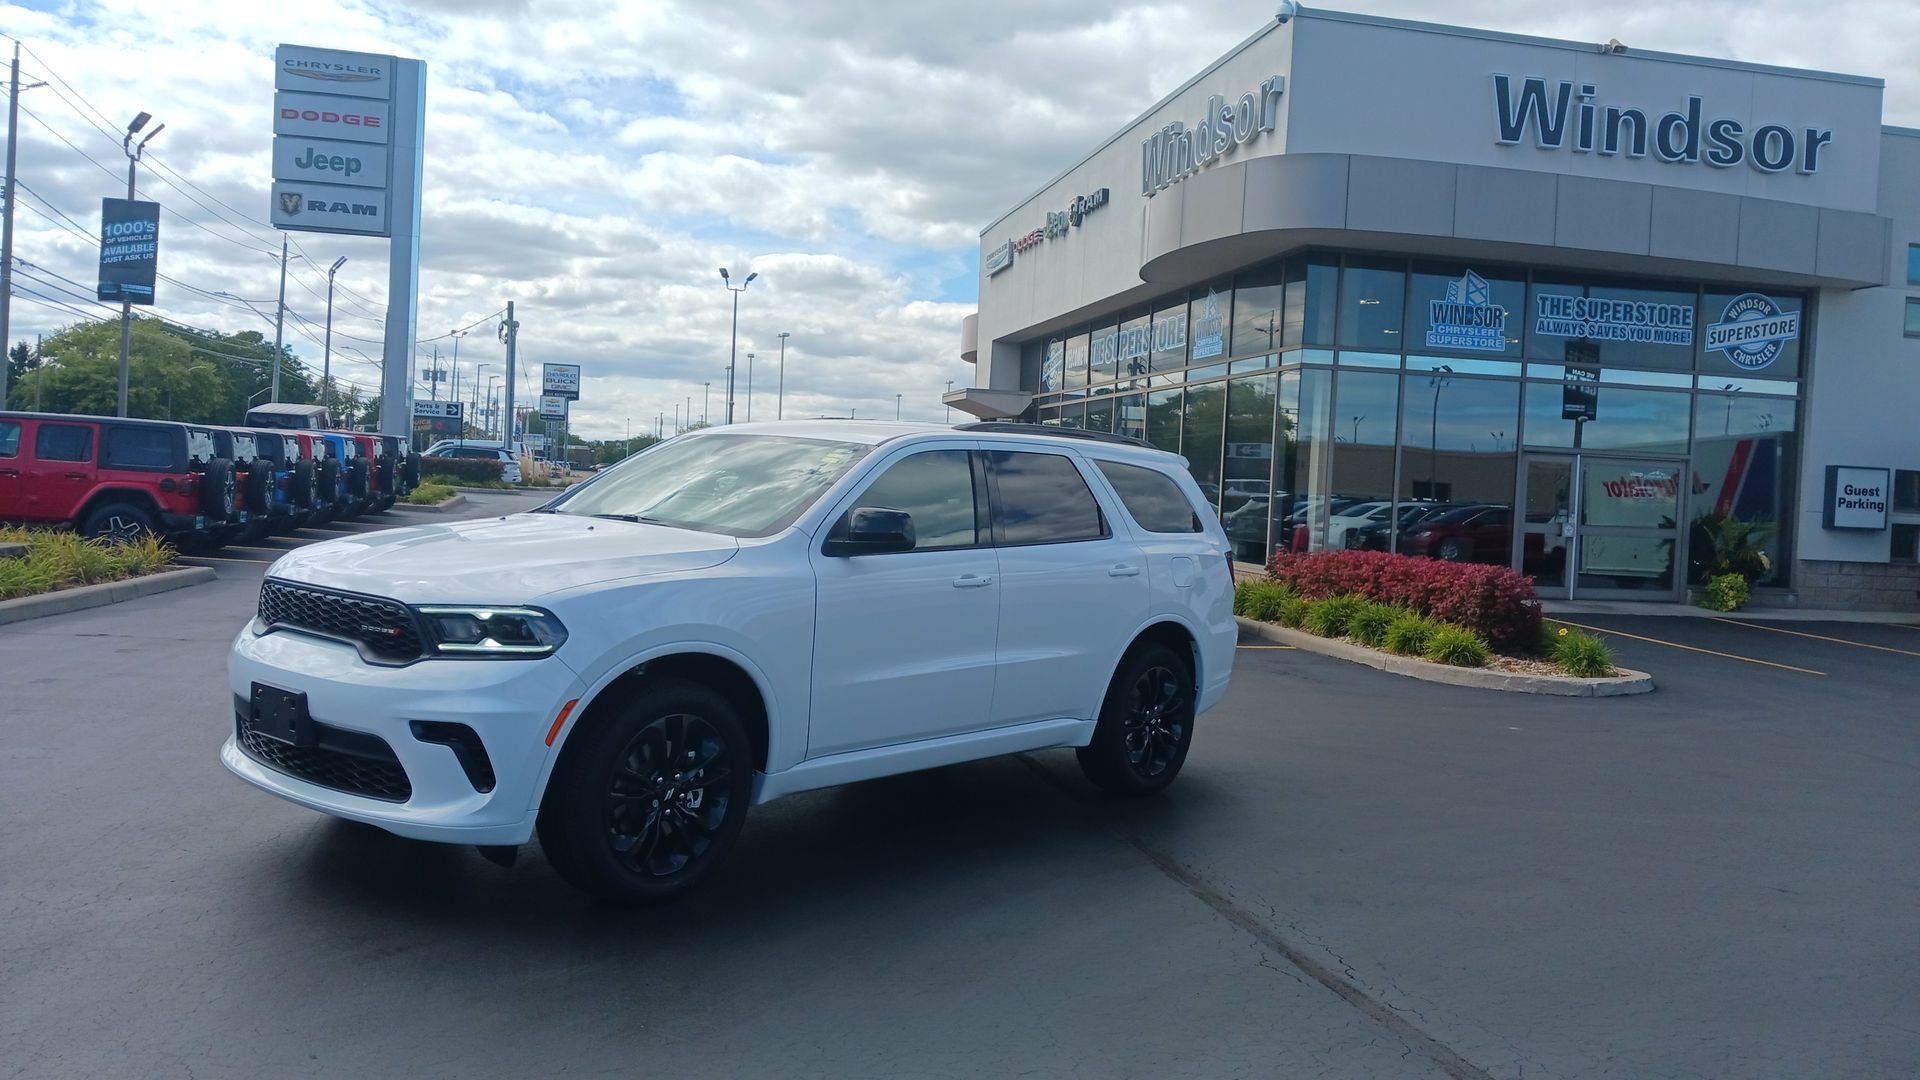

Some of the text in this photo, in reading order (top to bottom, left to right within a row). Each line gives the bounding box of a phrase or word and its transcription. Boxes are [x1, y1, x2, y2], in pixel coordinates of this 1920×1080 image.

[284, 59, 381, 75] CHRYSLER
[281, 108, 380, 128] DODGE
[1492, 73, 1833, 175] Windsor
[1141, 75, 1284, 198] Windsor
[294, 147, 362, 177] Jeep
[307, 199, 378, 217] RAM
[104, 220, 156, 236] 1000's
[1012, 228, 1044, 253] DODGE
[1078, 187, 1110, 215] RAM
[117, 234, 153, 243] VEHICLES
[103, 243, 155, 256] AVAILABLE
[103, 252, 154, 264] JUST ASK US
[1432, 303, 1503, 328] WINDSOR
[1538, 295, 1692, 327] THE SUPERSTORE
[1728, 299, 1772, 319] WINDSOR
[1091, 338, 1105, 366] THE
[1105, 314, 1187, 364] SUPERSTORE
[1429, 334, 1503, 348] SUPERSTORE
[1438, 325, 1495, 337] CHRYSLER
[1537, 320, 1691, 344] ALWAYS SAVES YOU MORE!
[1709, 319, 1795, 345] SUPERSTORE
[1733, 343, 1777, 365] CHRYSLER
[545, 377, 577, 385] BUICK
[1844, 484, 1880, 497] Guest
[1837, 497, 1885, 513] Parking
